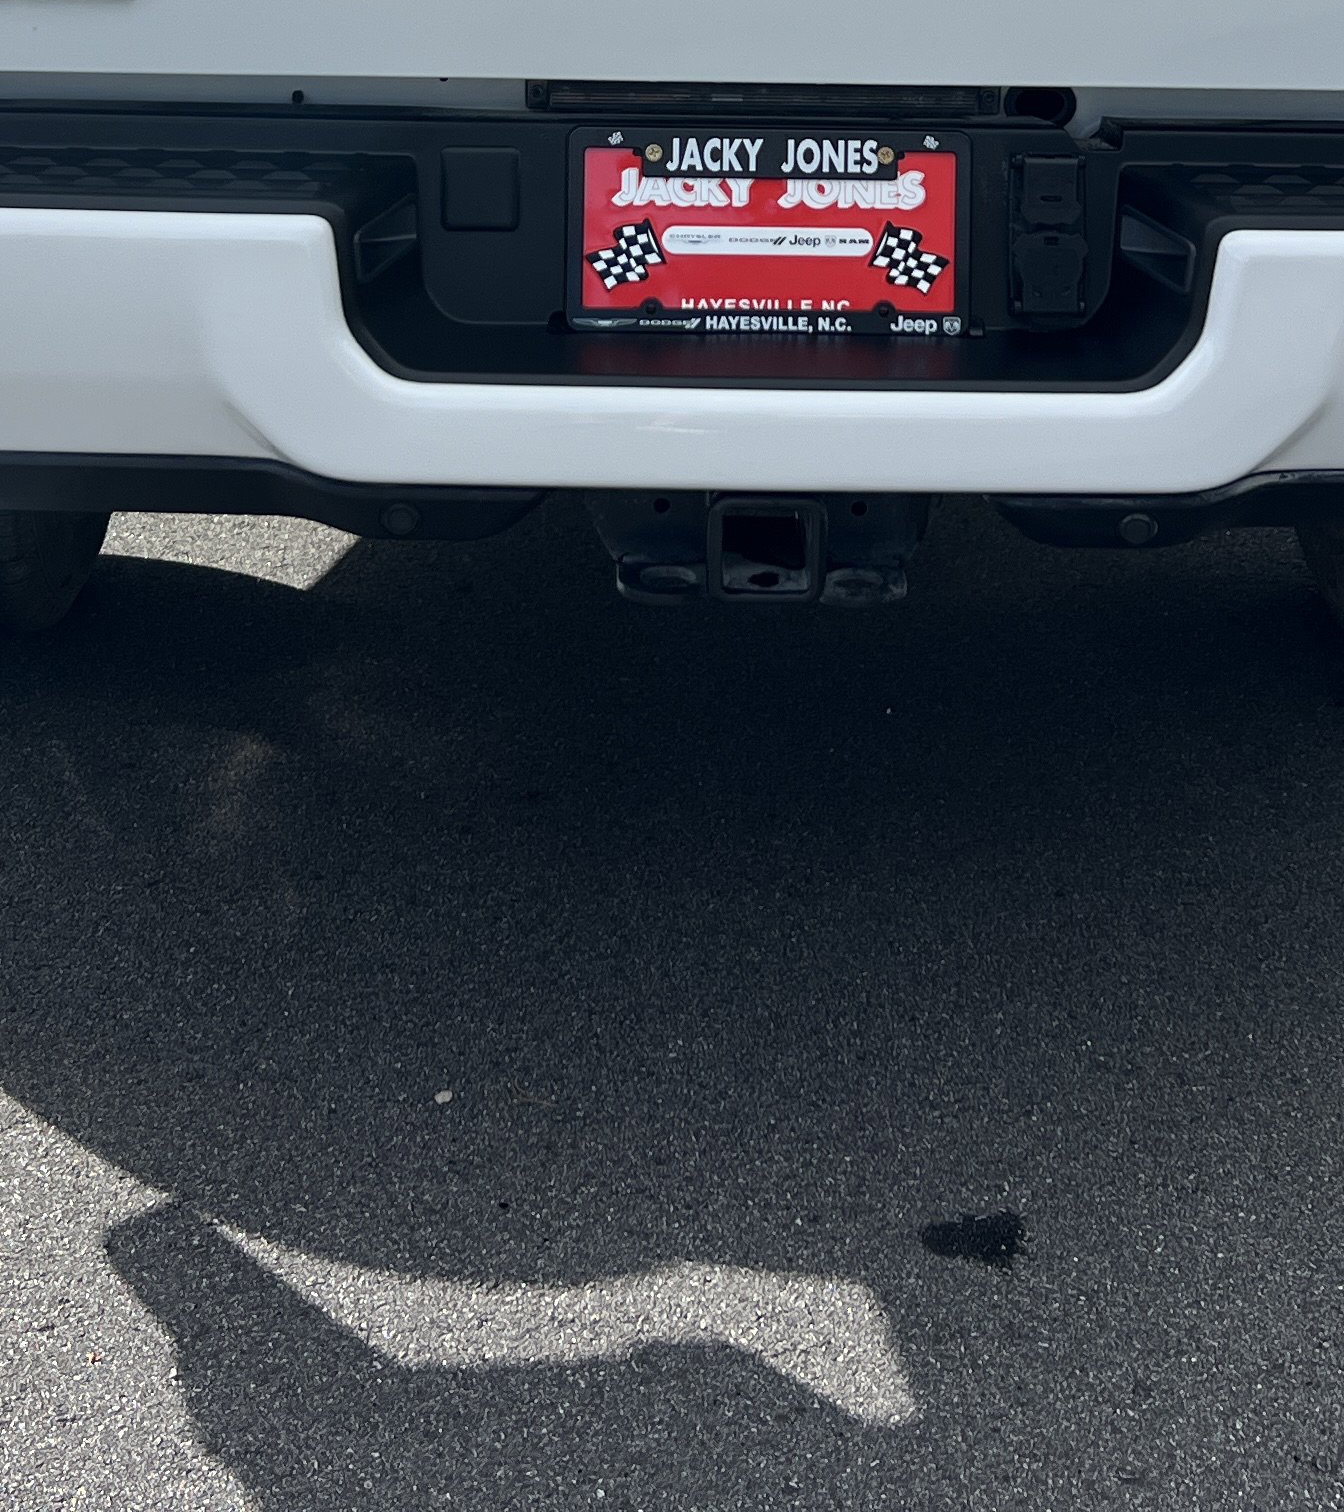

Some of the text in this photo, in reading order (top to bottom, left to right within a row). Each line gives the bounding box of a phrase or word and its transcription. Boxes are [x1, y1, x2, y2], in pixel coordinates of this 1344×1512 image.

[666, 137, 879, 174] JACKY JONES
[611, 167, 928, 210] JACKY JONES
[789, 234, 821, 248] Jeep
[705, 315, 813, 333] HAYESVILLE,
[817, 316, 853, 333] N.C.
[890, 315, 938, 335] Jeep
